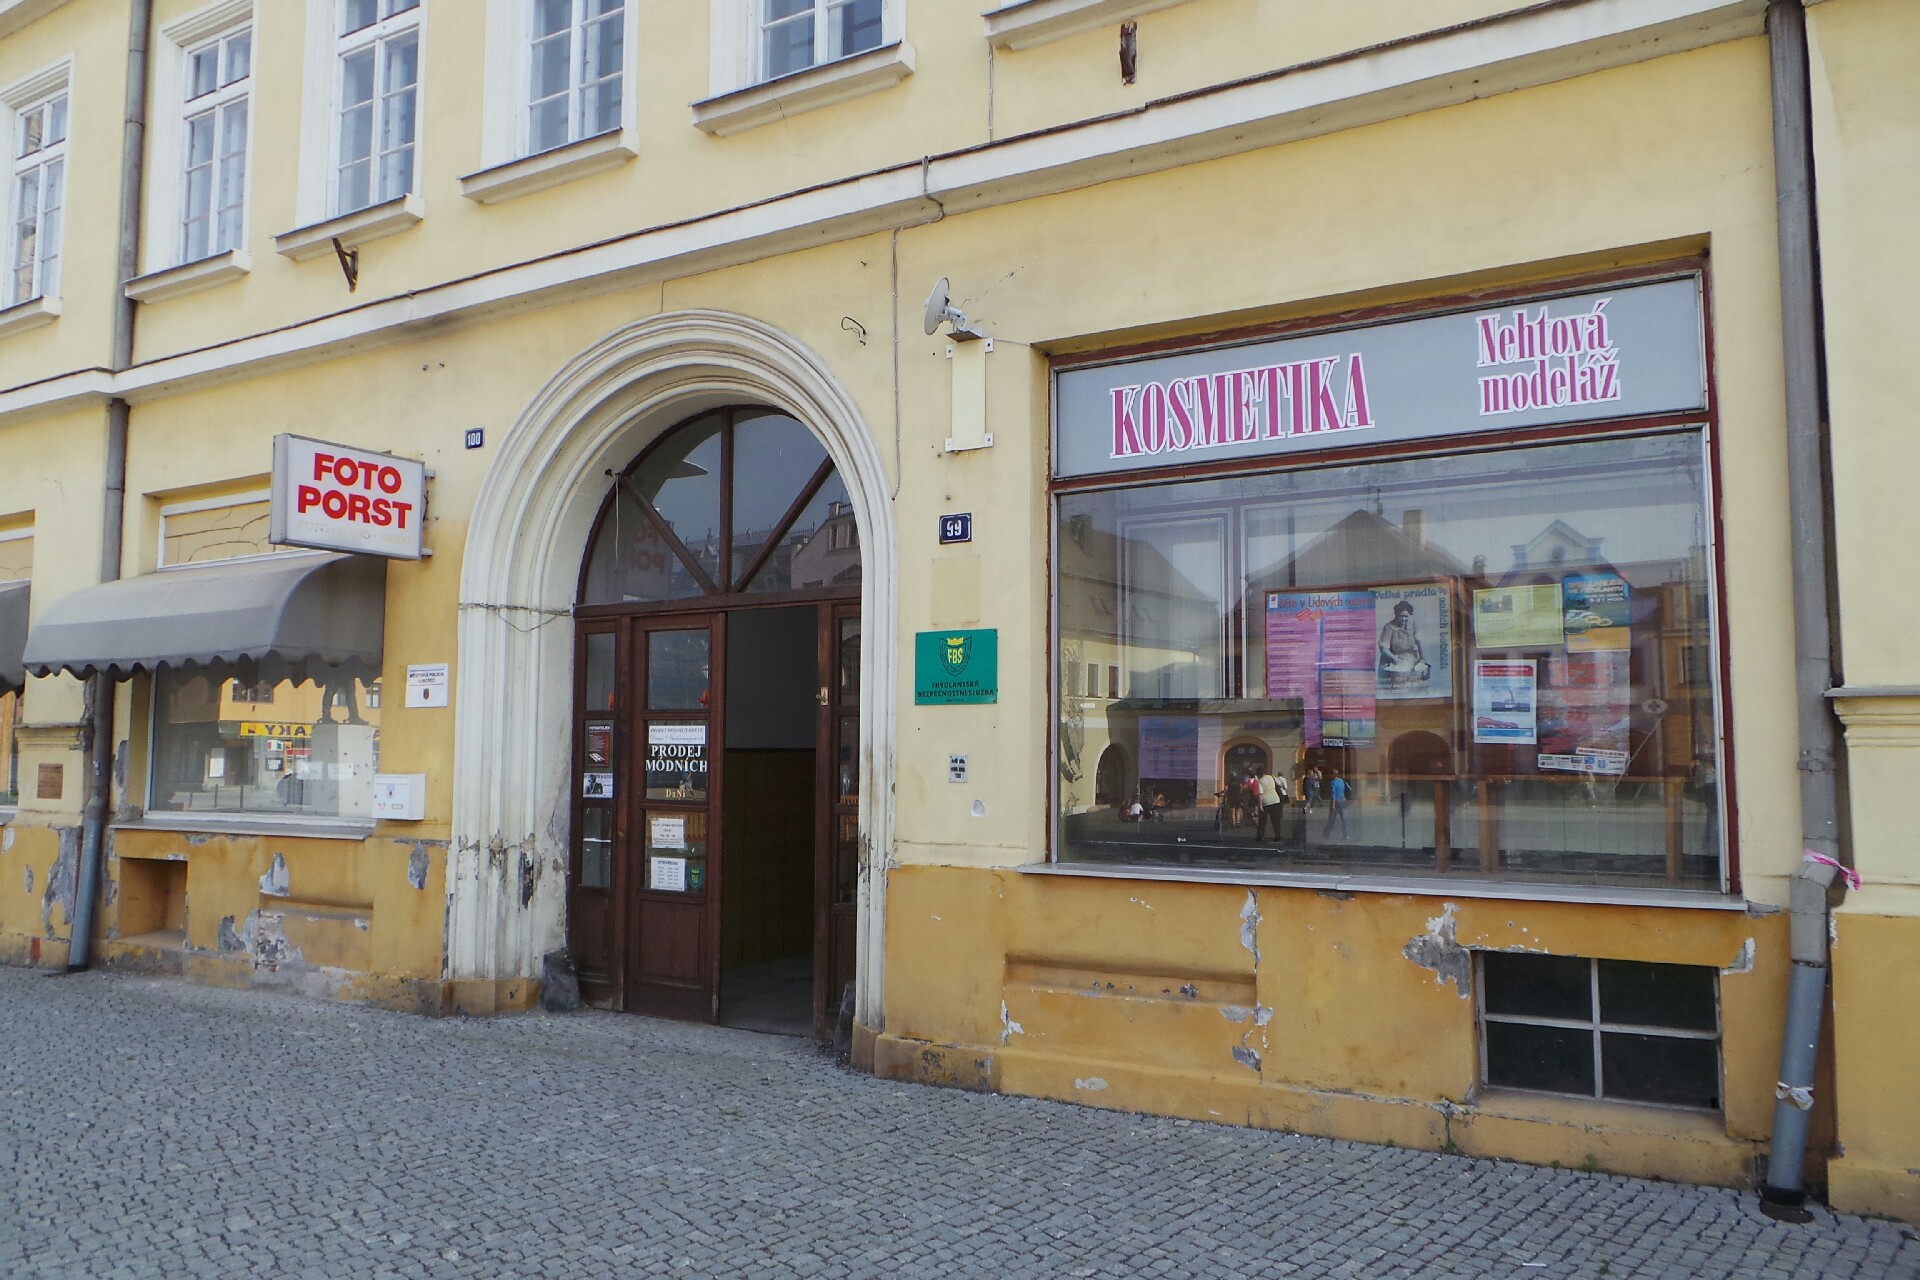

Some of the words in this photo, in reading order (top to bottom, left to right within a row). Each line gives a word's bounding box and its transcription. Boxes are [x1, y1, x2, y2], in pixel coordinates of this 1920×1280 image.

[1476, 298, 1613, 368] Nehtová
[1478, 348, 1621, 415] modeláž
[1110, 353, 1374, 459] KOSMETIKA
[467, 432, 481, 446] 100
[313, 452, 402, 494] FOTO
[297, 484, 413, 529] PORST
[946, 519, 962, 537] 99
[947, 647, 964, 664] FBS
[645, 757, 708, 772] MÓDNÍCH
[651, 745, 702, 758] PRODEJ
